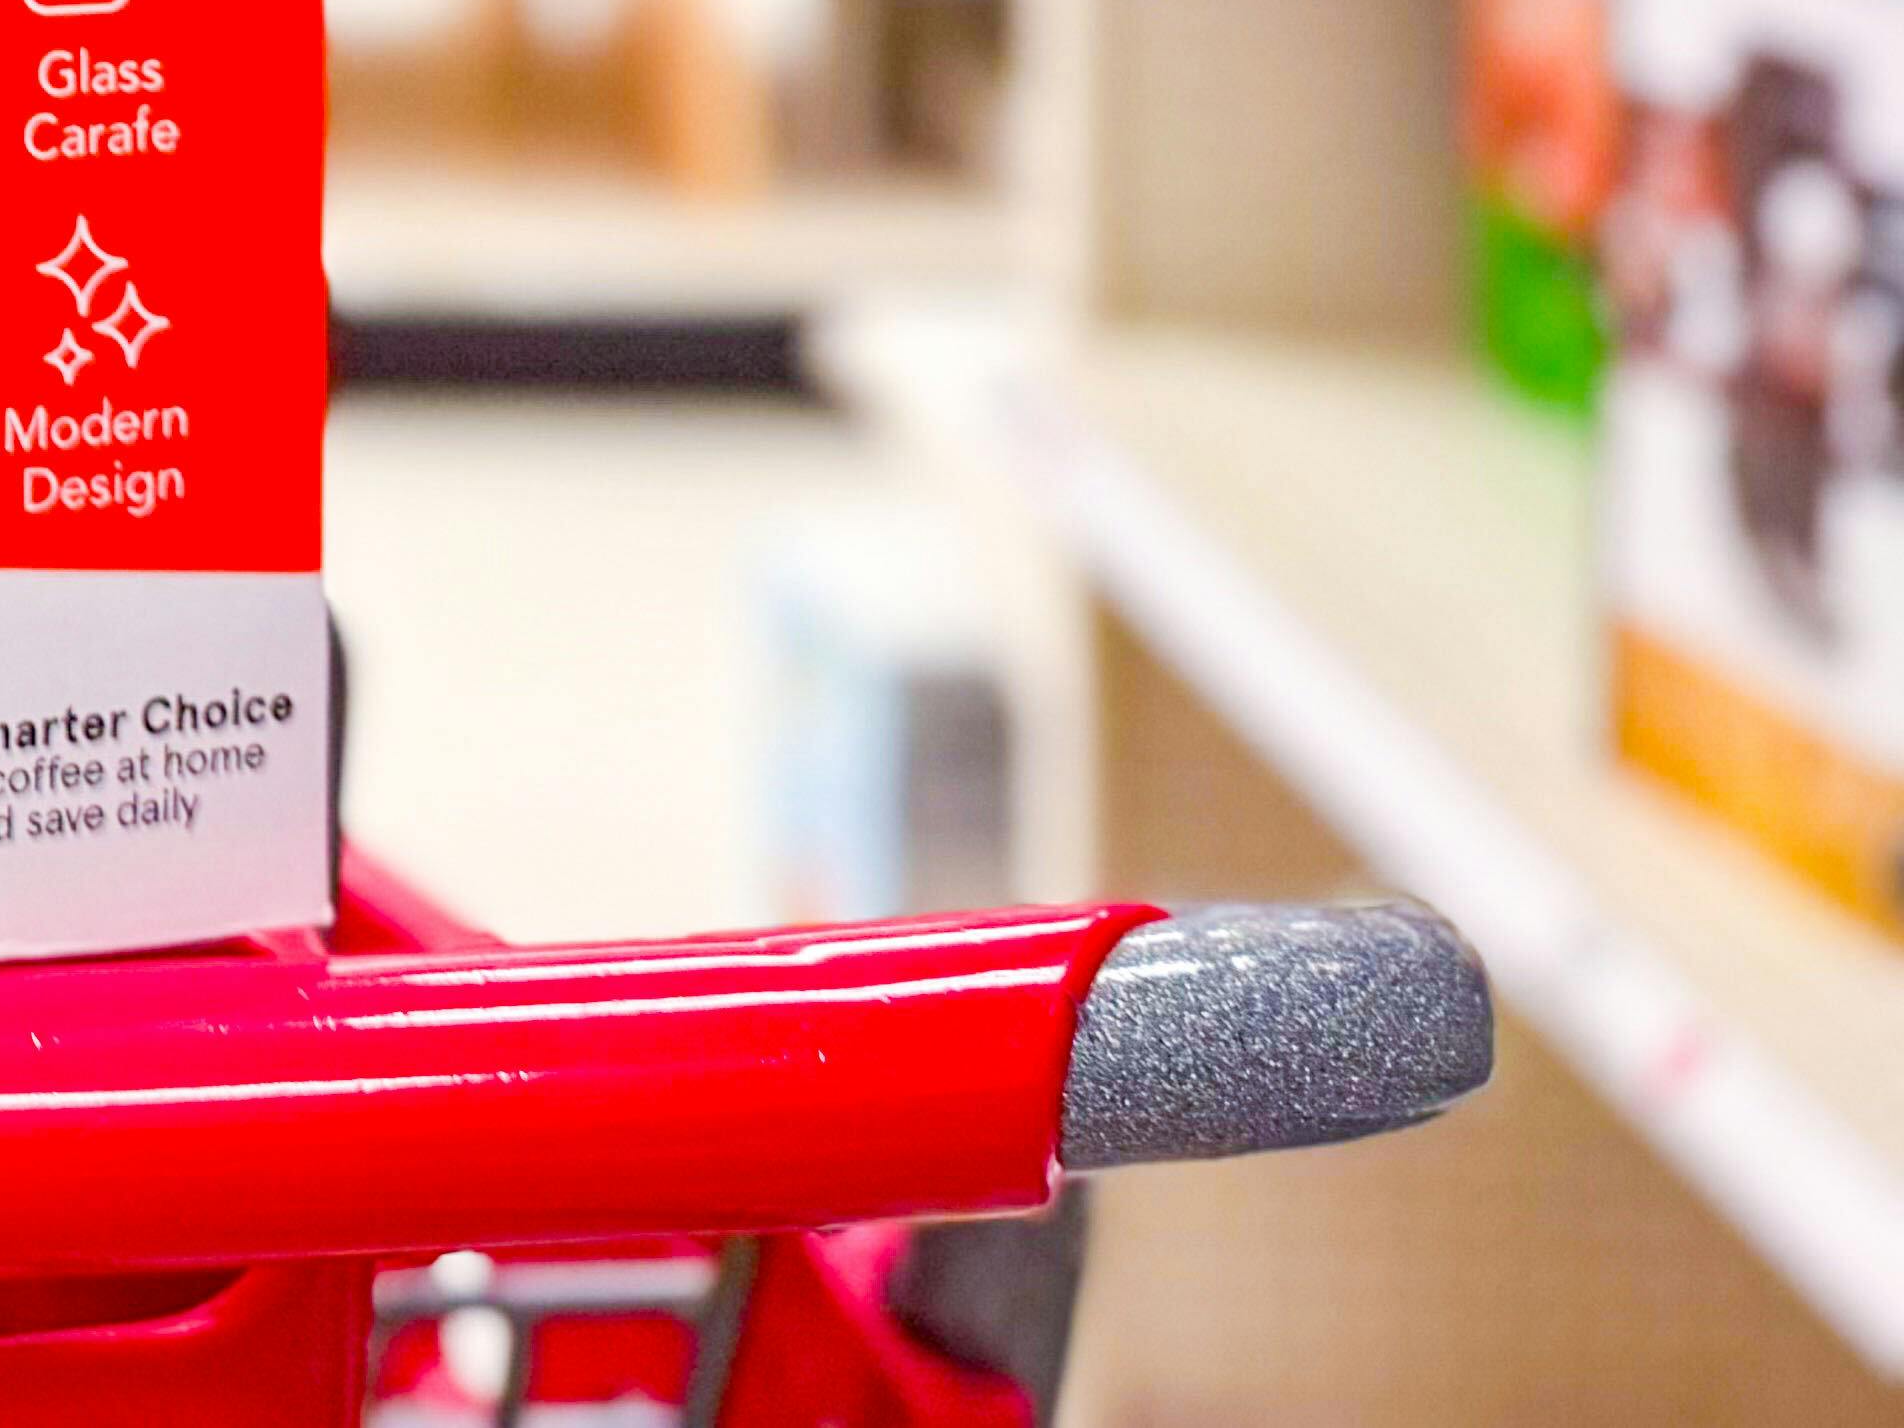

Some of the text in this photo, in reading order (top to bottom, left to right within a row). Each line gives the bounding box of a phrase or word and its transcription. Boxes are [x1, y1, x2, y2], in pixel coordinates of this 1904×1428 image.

[38, 47, 164, 97] Glass
[23, 104, 180, 161] Carafe
[5, 397, 189, 454] Modern
[22, 460, 185, 516] Design
[141, 689, 295, 737] Choice
[116, 749, 153, 787] at
[161, 738, 267, 779] home
[25, 804, 106, 840] save
[116, 789, 198, 843] daily
